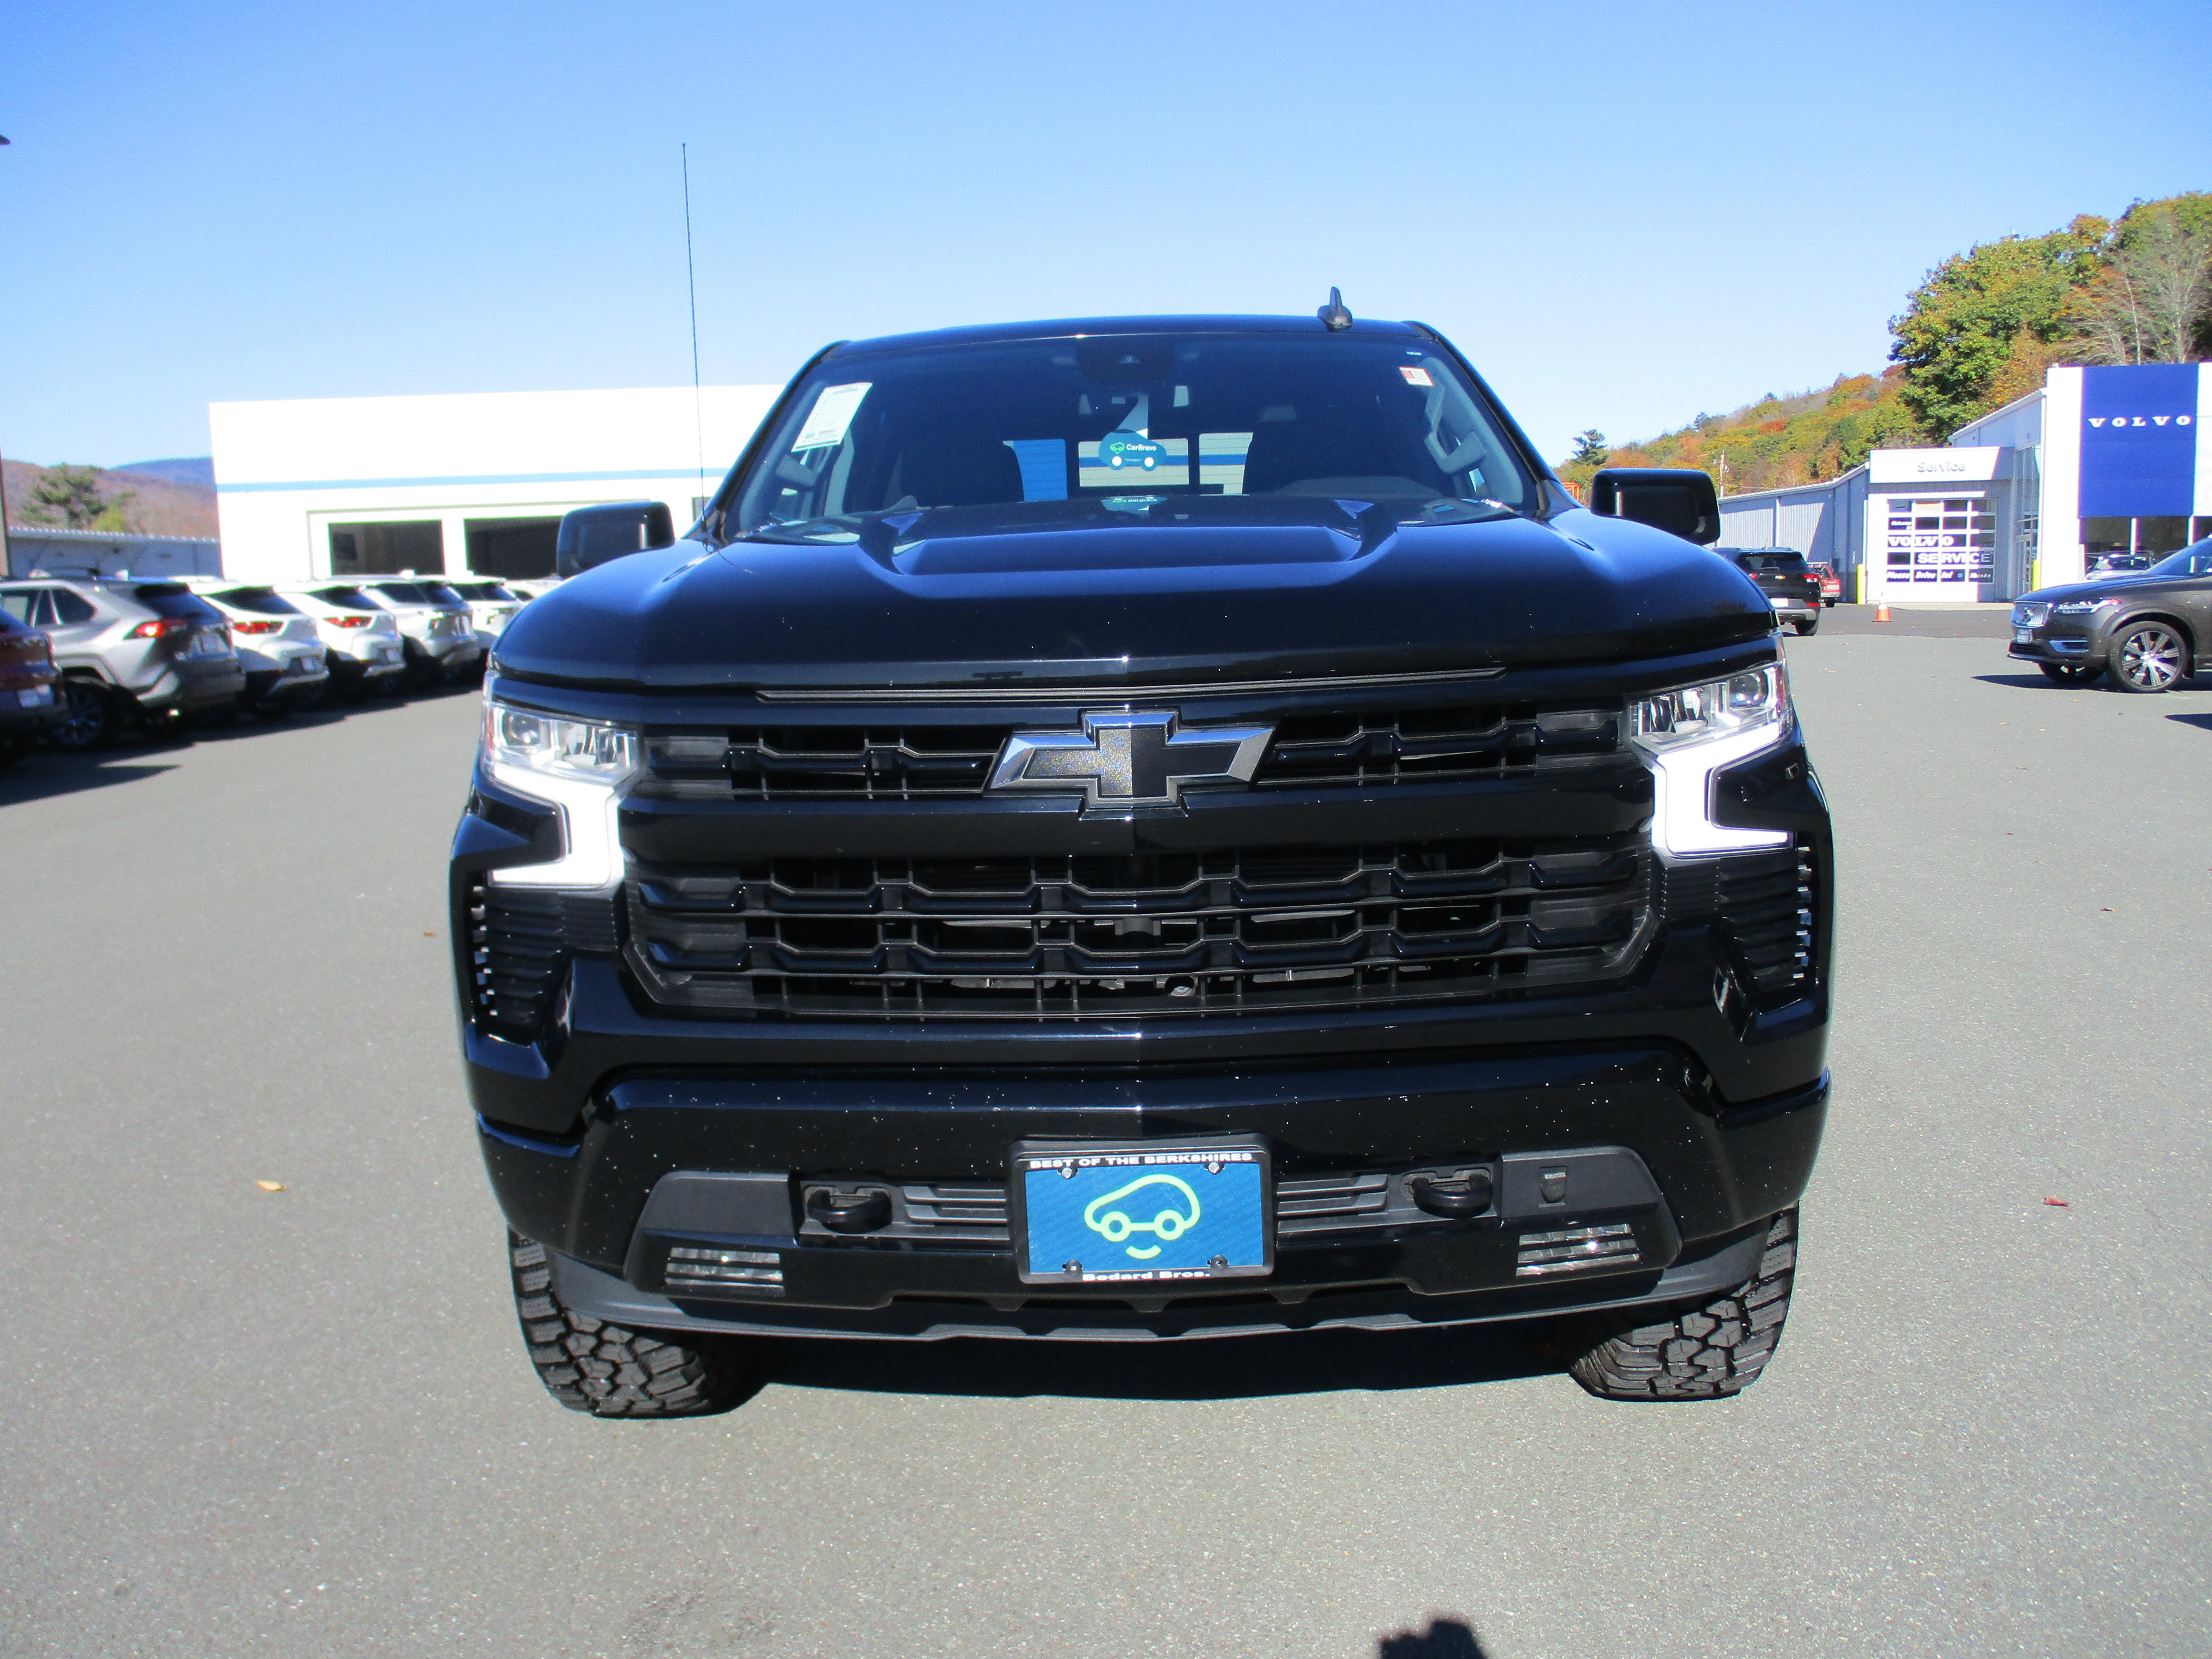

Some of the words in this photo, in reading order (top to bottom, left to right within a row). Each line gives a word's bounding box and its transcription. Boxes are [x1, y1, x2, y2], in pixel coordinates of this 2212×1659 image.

[2087, 415, 2191, 428] VOLVO
[1917, 461, 1966, 473] Service
[1887, 535, 1954, 547] VOLVO
[1917, 552, 1990, 564] SERVICE
[1915, 571, 1936, 579] Drive
[1030, 1159, 1074, 1170] BEST
[1078, 1158, 1101, 1167] OF
[1105, 1156, 1140, 1166] THE
[1144, 1153, 1253, 1165] BERKSHIRES
[1082, 1271, 1153, 1282] Bedard
[1159, 1270, 1211, 1279] Bros.
